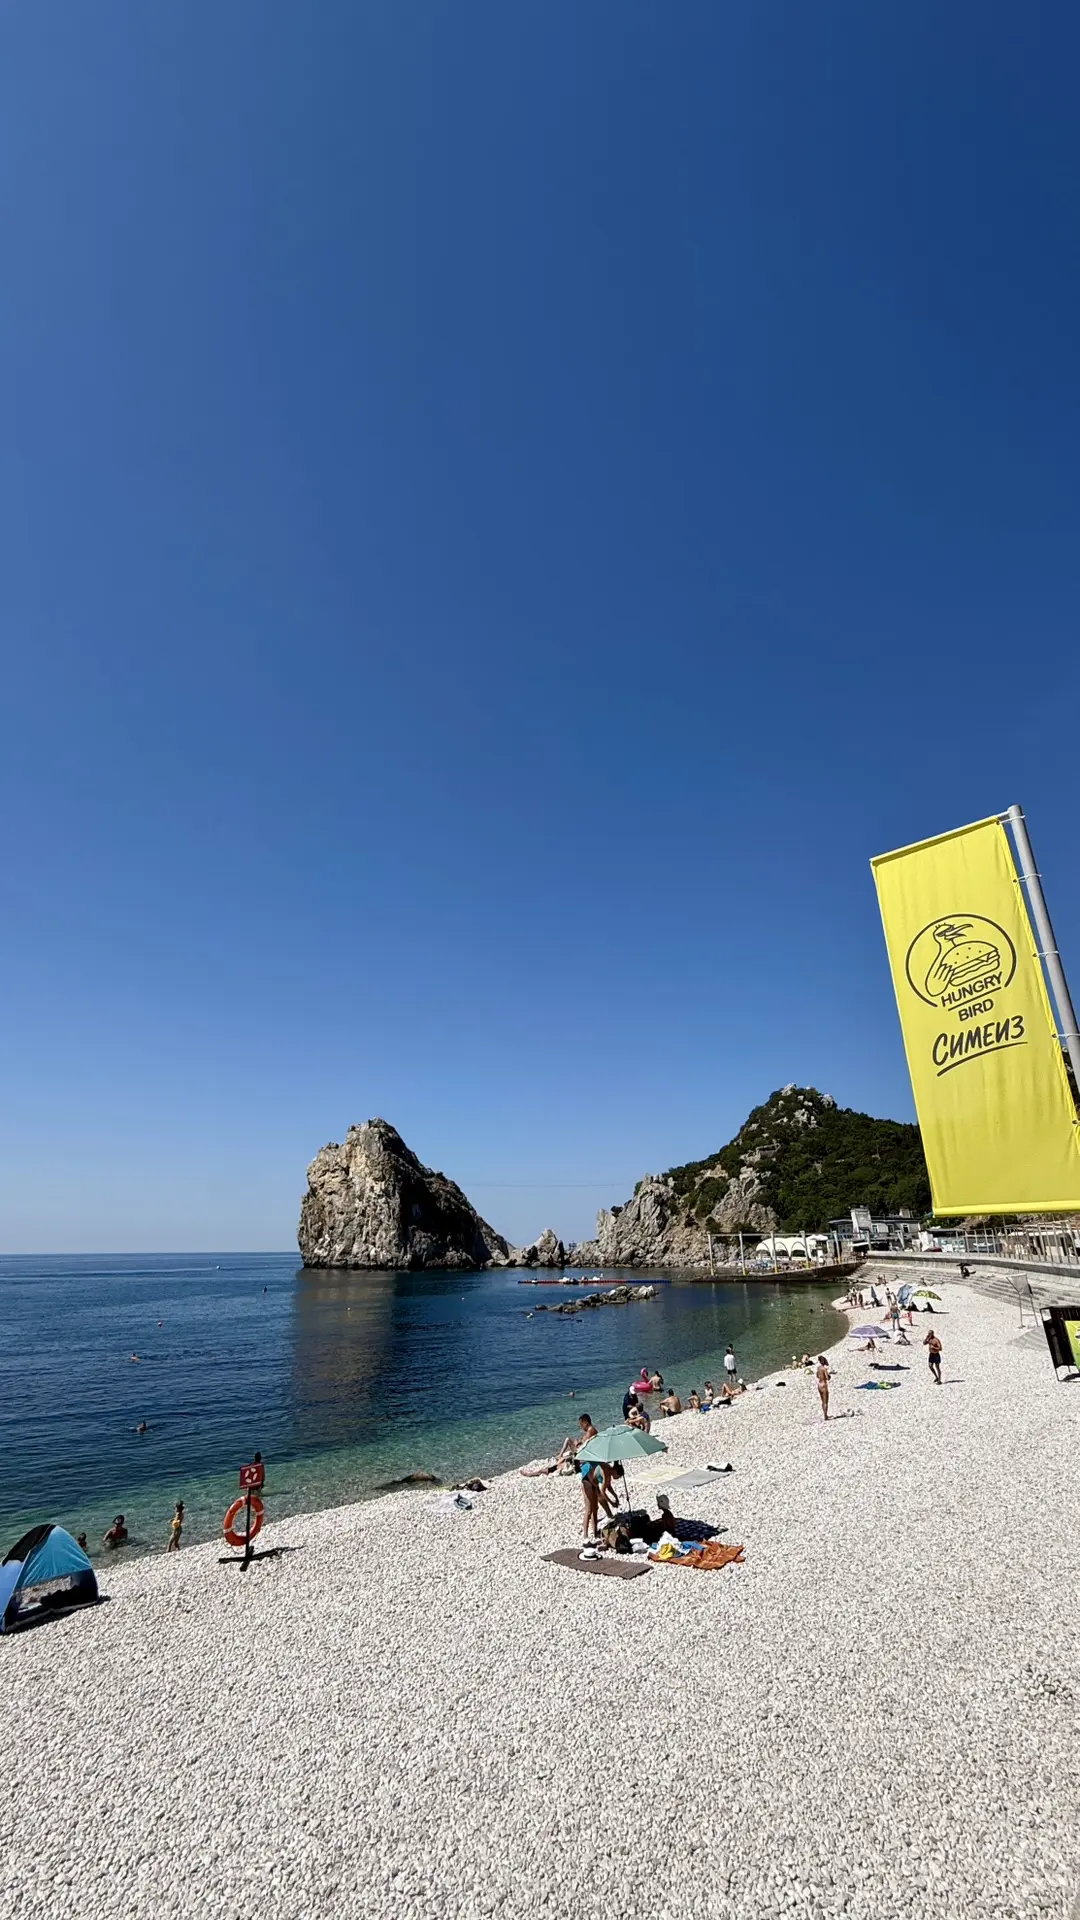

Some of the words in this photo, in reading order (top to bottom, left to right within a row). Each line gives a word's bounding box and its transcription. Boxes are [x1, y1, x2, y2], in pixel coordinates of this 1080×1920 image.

[941, 971, 1003, 1007] HUNGRY
[958, 998, 994, 1022] BIRD
[932, 1015, 1025, 1066] СИМЕИЗ
